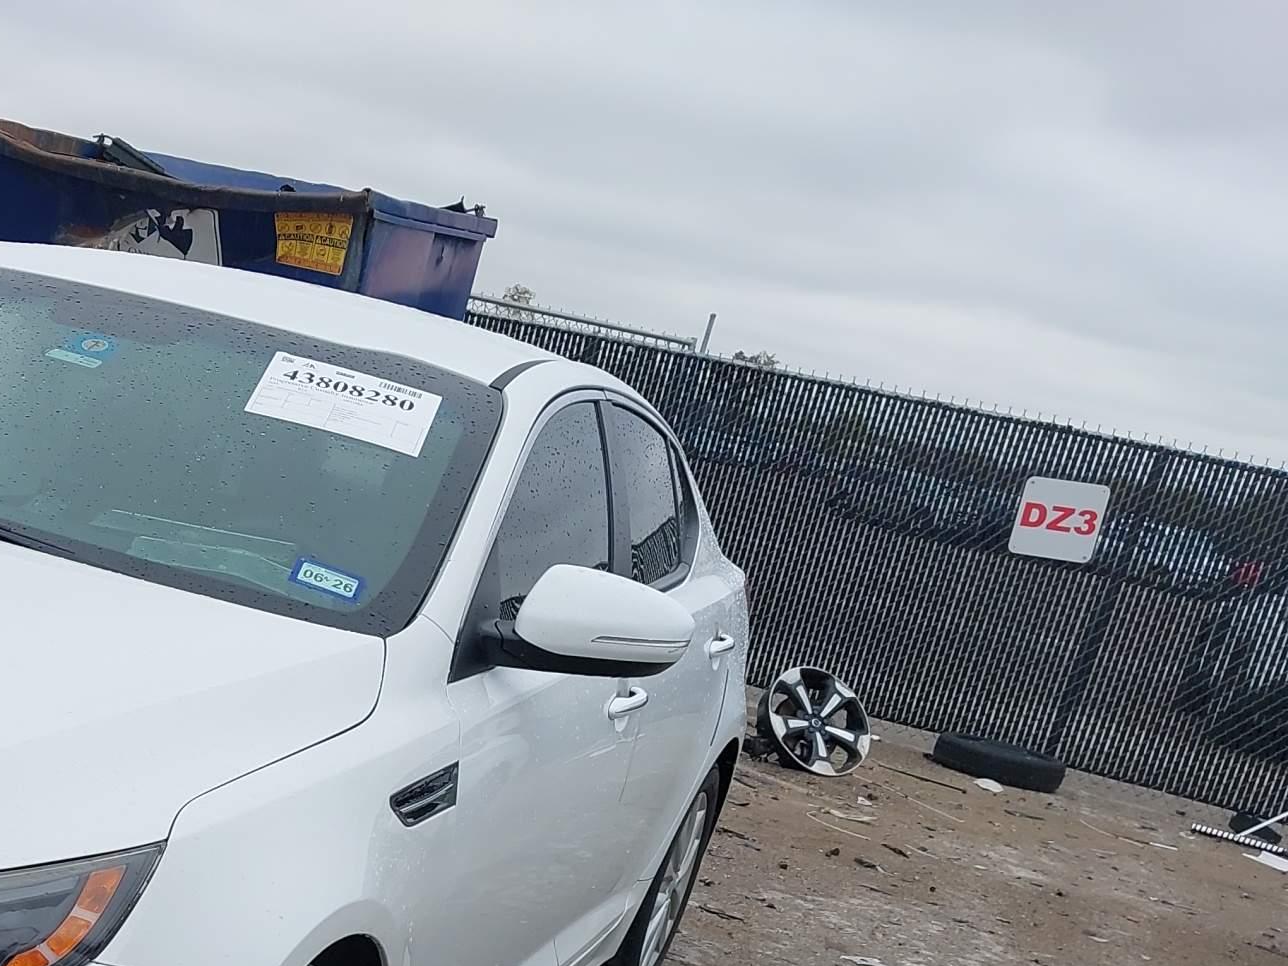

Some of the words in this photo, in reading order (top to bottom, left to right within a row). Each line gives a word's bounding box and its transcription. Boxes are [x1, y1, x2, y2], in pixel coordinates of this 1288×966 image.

[285, 232, 314, 243] CAUTION
[320, 236, 348, 249] CAUTION
[282, 369, 415, 411] 43808280
[1020, 502, 1098, 535] DZ3
[302, 568, 324, 583] 06
[332, 578, 354, 594] 26
